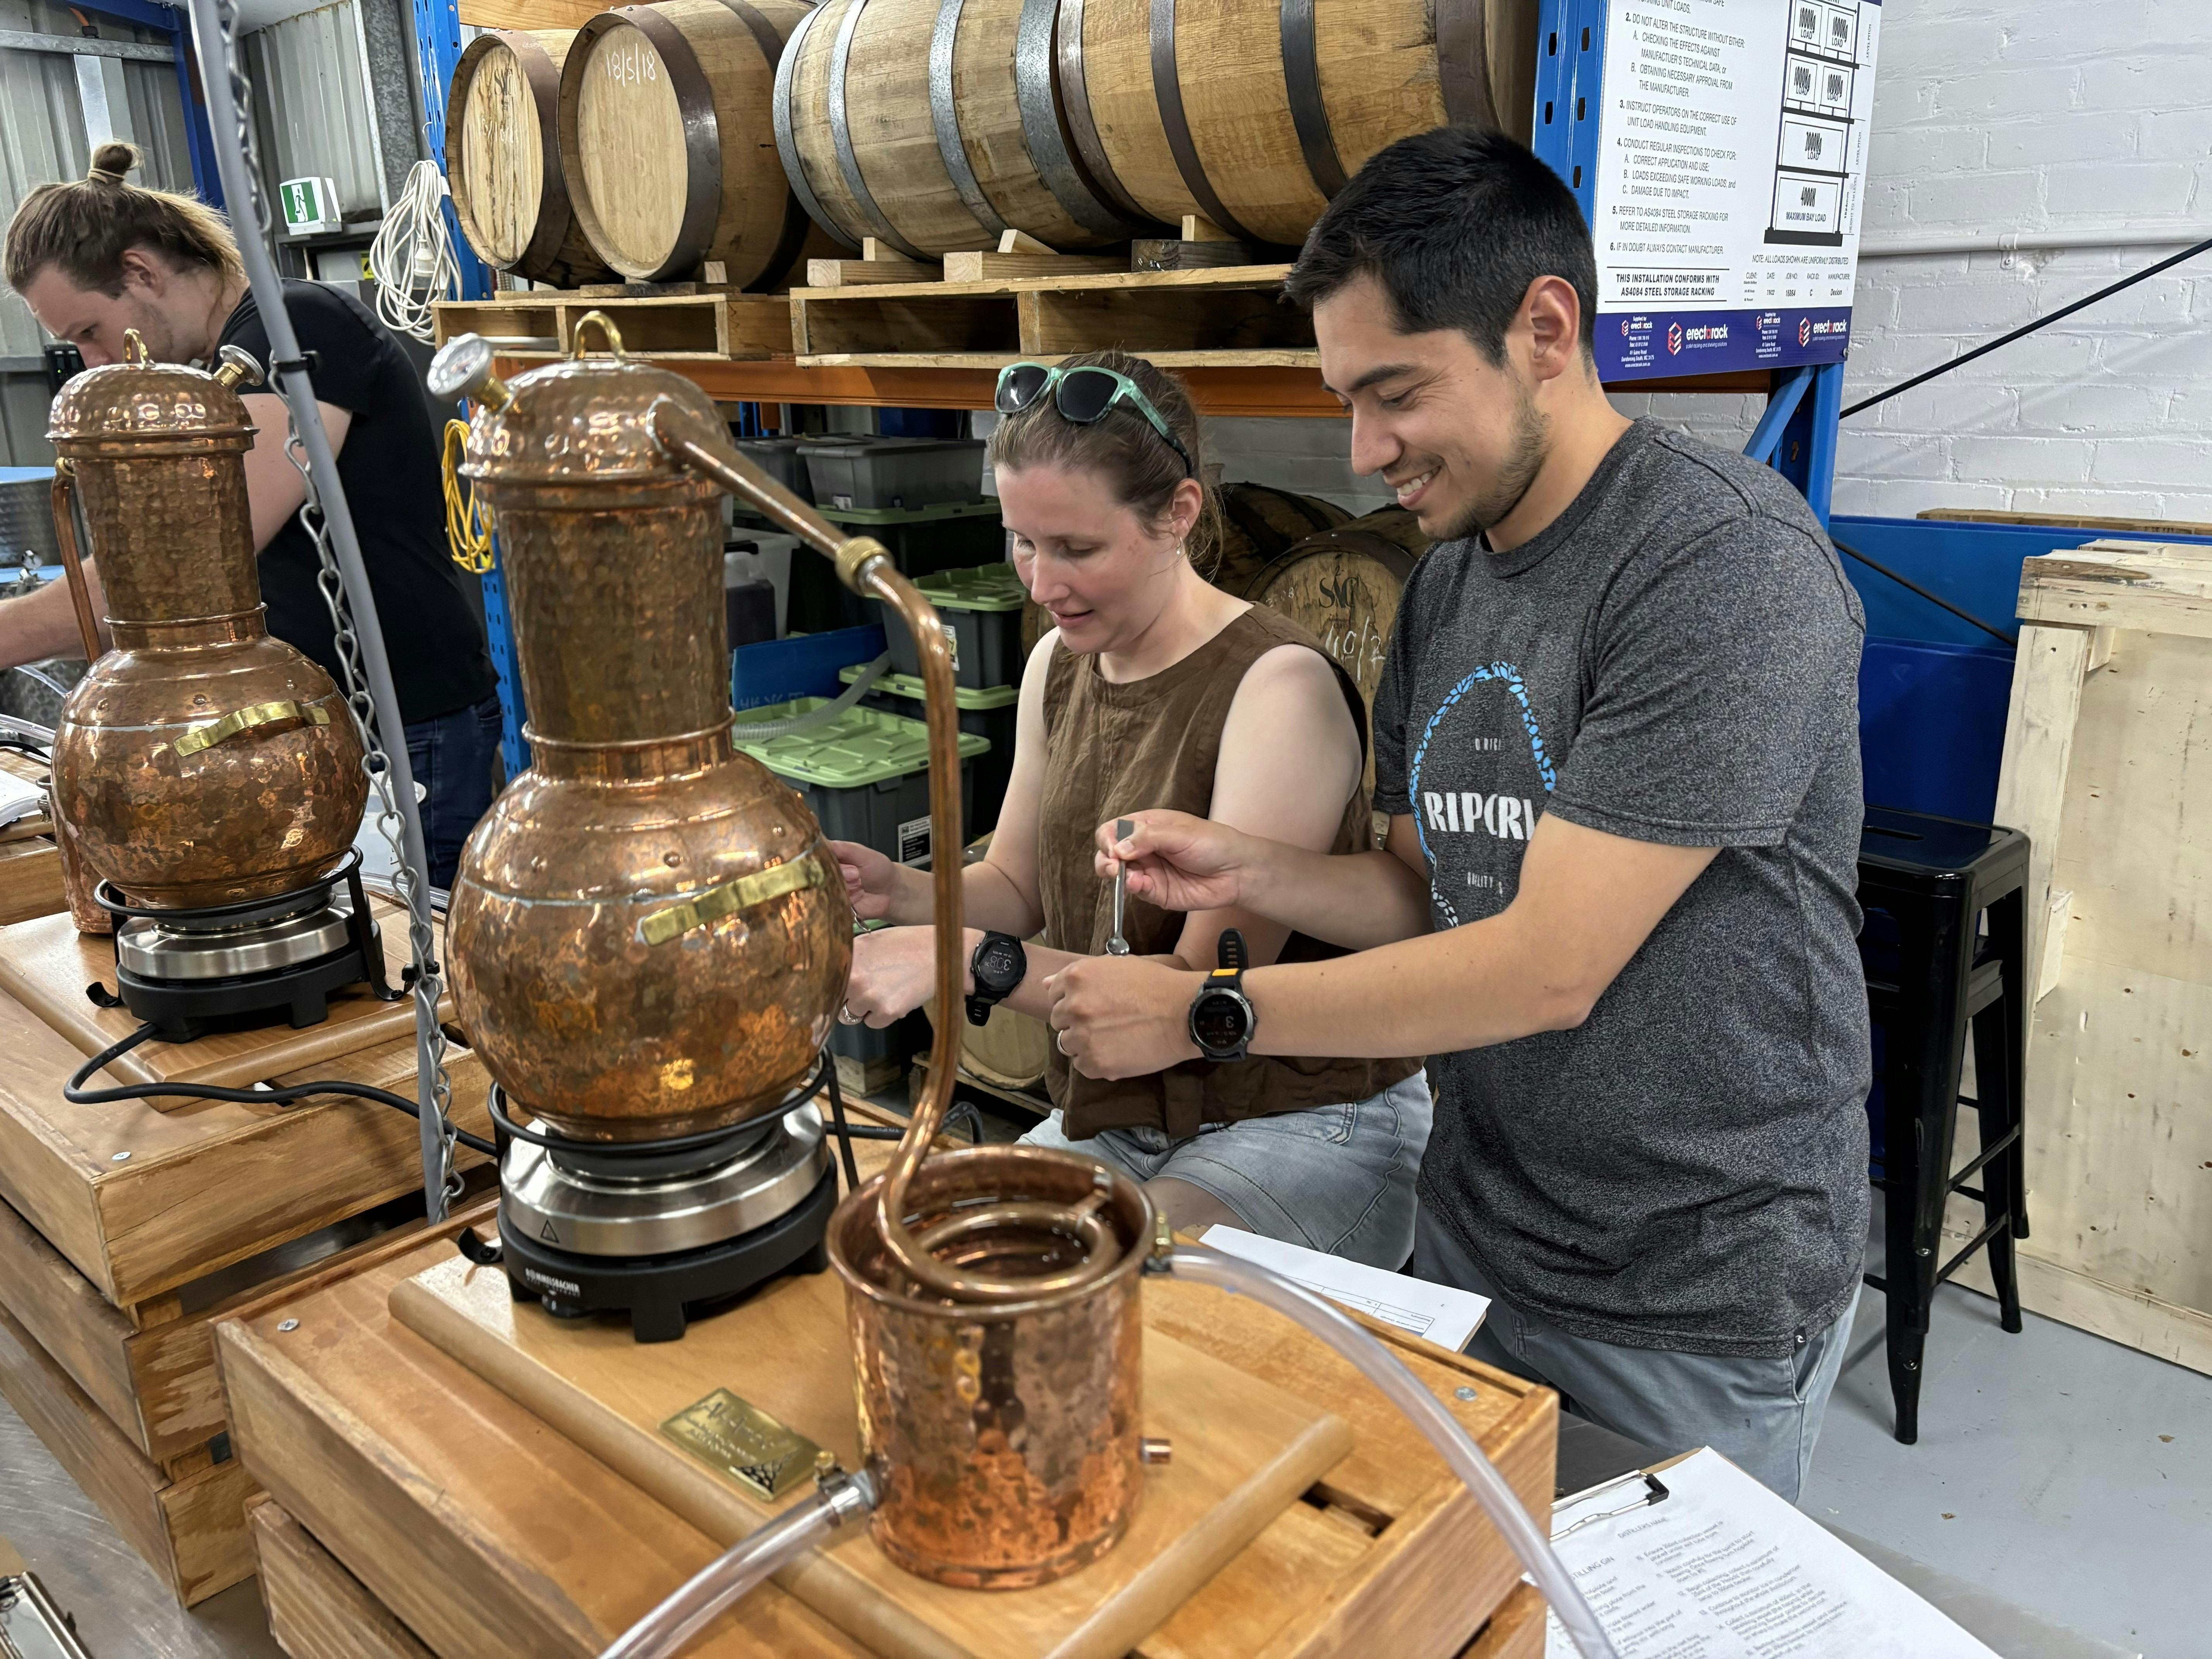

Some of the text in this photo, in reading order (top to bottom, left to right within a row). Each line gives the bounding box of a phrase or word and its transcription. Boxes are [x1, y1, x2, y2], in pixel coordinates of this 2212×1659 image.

[1662, 0, 1691, 14] UNIT LOADS.
[1800, 7, 1815, 34] 1000Kg
[1626, 12, 1745, 48] 2. DO NOT ALTER THE STRUCTURE WITHOUT EITHER:
[1801, 30, 1812, 39] LOAD
[1832, 17, 1848, 43] 1000Kg
[1633, 30, 1720, 58] A. CHECKING THE EFFECTS AGAINST
[1832, 38, 1843, 47] LOAD
[606, 43, 656, 87] 18/5/18
[1683, 57, 1708, 70] TECHNICAL
[1631, 62, 1733, 89] B. OBTAINING NECESSARY APPROVAL FROM
[1639, 80, 1690, 97] THE MANUFACTURER.
[1796, 86, 1808, 95] LOAD
[1827, 93, 1838, 101] LOAD
[1620, 100, 1737, 125] 3. INSTRUCT OPERATORS ON THE CORRECT USE OF
[1627, 116, 1707, 136] UNIT LOAD HANDLING EQUIPMENT.
[1617, 137, 1736, 160] 4. CONDUCT REGULAR INSPECTIONS TO CHECK FOR:
[1807, 151, 1819, 160] LOAD
[1625, 154, 1710, 172] A. CORRECT APPLICATION AND USE;
[1623, 169, 1628, 179] B.
[1632, 170, 1649, 180] LOADS
[1650, 172, 1677, 183] EXCEEDING
[1678, 174, 1690, 184] SAFE
[1690, 175, 1711, 186] WORKING
[1623, 184, 1689, 199] C. DAMAGE DUE TO IMPACT.
[1612, 206, 1728, 221] 5. REFER TO AS4084 STEEL STORAGE RACKING FOR
[1786, 212, 1826, 222] MAXIMUM BAY LOAD
[1620, 221, 1691, 233] MORE DETAILED INFORMATION.
[1610, 242, 1724, 254] 6. IF IN DOUBT ALWAYS CONTACT MANUFACTURER.
[1752, 254, 1764, 263] NOTE:
[1772, 255, 1785, 263] LOADS
[1786, 256, 1800, 264] SHOWN
[1808, 256, 1829, 264] UNIFORMLY
[1616, 274, 1719, 283] THIS INSTALLATION CONFORMS WITH
[1621, 287, 1714, 296] AS4084 STEEL STORAGE RACKING
[1686, 324, 1728, 340] erectarack
[1813, 319, 1847, 334] erectarack
[1601, 1556, 1614, 1566] GIN
